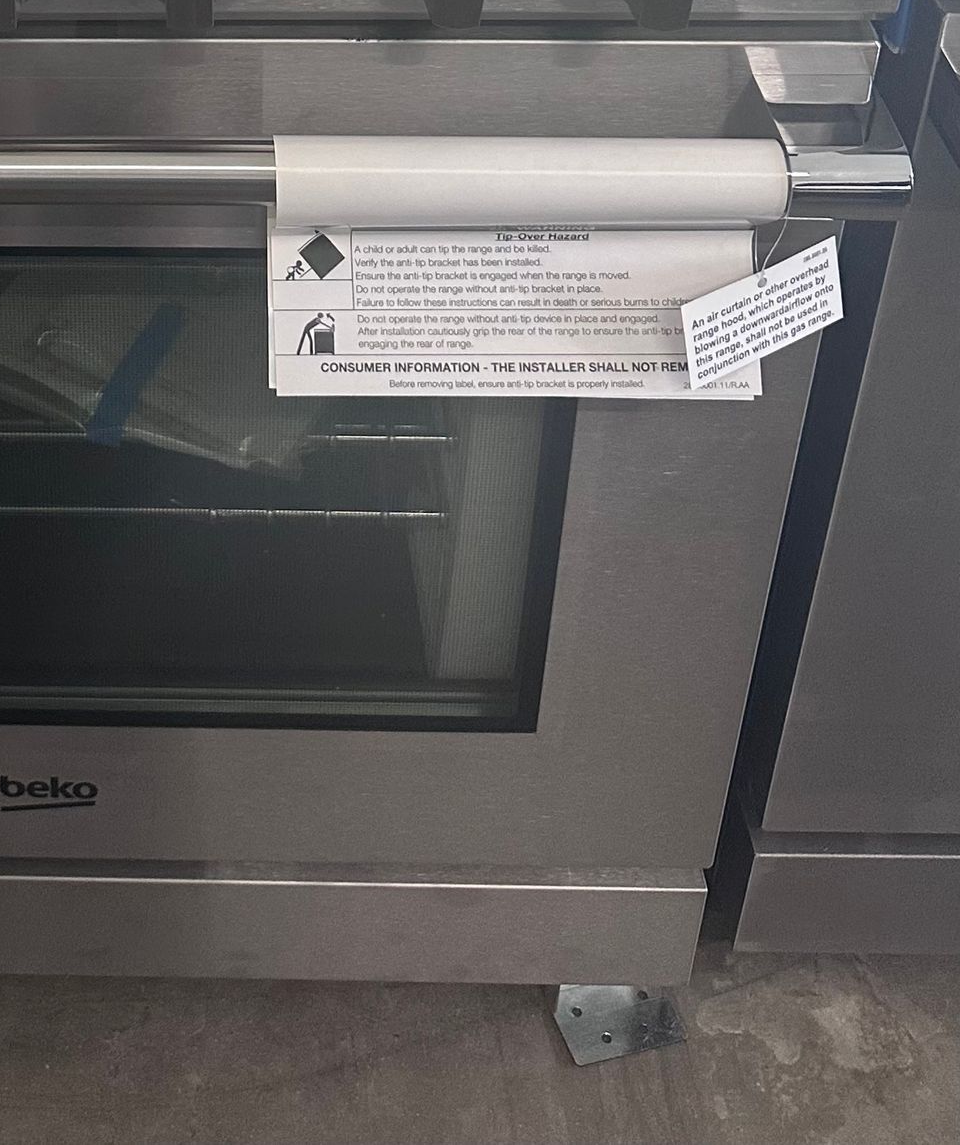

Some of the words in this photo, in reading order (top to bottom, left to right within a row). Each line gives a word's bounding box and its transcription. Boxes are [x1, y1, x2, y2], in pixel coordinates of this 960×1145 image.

[495, 233, 545, 242] Tip-Over
[548, 232, 590, 241] Hazard
[354, 245, 360, 253] A
[362, 245, 383, 253] child
[396, 245, 417, 253] adult
[438, 245, 448, 255] tip
[451, 245, 465, 253] the
[467, 246, 492, 255] range
[494, 245, 511, 253] and
[513, 245, 525, 253] be
[527, 245, 552, 253] killed.
[354, 258, 378, 268] Verify
[380, 258, 394, 266] the
[396, 258, 426, 268] anti-tip
[428, 258, 460, 266] bracket
[462, 258, 478, 266] has
[480, 258, 502, 266] been
[504, 258, 544, 266] installed.
[355, 271, 385, 279] Ensure
[387, 271, 400, 279] the
[403, 271, 433, 281] anti-tip
[434, 271, 467, 279] bracket
[469, 271, 477, 279] is
[479, 271, 517, 281] engaged
[519, 271, 543, 279] when
[545, 271, 560, 279] the
[562, 272, 587, 281] range
[589, 271, 596, 279] is
[598, 271, 632, 279] moved.
[356, 284, 368, 293] Do
[370, 284, 384, 293] not
[386, 284, 420, 294] operate
[422, 284, 436, 293] the
[438, 286, 463, 294] range
[465, 284, 496, 293] without
[499, 284, 529, 294] anti-tip
[531, 284, 564, 293] bracket
[566, 284, 574, 293] in
[576, 284, 603, 294] place.
[692, 318, 704, 330] An
[707, 312, 718, 323] air
[721, 297, 752, 316] curtain
[754, 291, 763, 301] or
[765, 280, 788, 296] other
[790, 260, 829, 284] overhead
[356, 298, 383, 306] Failure
[386, 298, 394, 306] to
[396, 298, 421, 306] follow
[423, 298, 446, 306] these
[448, 298, 497, 306] instructions
[517, 298, 541, 306] result
[542, 298, 551, 306] in
[552, 298, 577, 306] death
[590, 298, 621, 306] serious
[623, 298, 648, 306] burns
[650, 298, 659, 306] to
[693, 326, 719, 342] range
[722, 313, 746, 328] hood,
[748, 299, 774, 316] which
[776, 282, 813, 304] operates
[815, 275, 826, 286] by
[356, 314, 370, 322] Do
[371, 314, 386, 322] not
[388, 314, 421, 324] operate
[424, 314, 438, 322] the
[440, 316, 464, 324] range
[466, 314, 498, 322] without
[501, 314, 531, 324] anti-tip
[533, 314, 562, 322] device
[563, 314, 572, 322] in
[574, 314, 598, 324] place
[600, 314, 617, 322] and
[619, 314, 662, 324] engaged.
[695, 334, 730, 354] blowing
[733, 330, 738, 338] a
[815, 284, 834, 297] onto
[357, 327, 377, 335] After
[380, 327, 425, 335] installation
[427, 327, 470, 337] cautiously
[472, 327, 489, 337] grip
[492, 327, 505, 335] the
[527, 327, 536, 335] of
[538, 327, 552, 335] the
[554, 328, 579, 337] range
[582, 327, 591, 335] to
[625, 327, 638, 335] the
[642, 327, 673, 337] anti-tip
[696, 353, 713, 367] this
[716, 341, 744, 358] range,
[746, 327, 766, 344] shall
[769, 321, 783, 333] not
[785, 314, 795, 326] be
[798, 303, 818, 319] used
[820, 299, 828, 308] in
[358, 340, 398, 350] engaging
[400, 340, 414, 348] the
[435, 340, 444, 348] of
[446, 341, 474, 350] range.
[698, 349, 750, 379] conjunction
[752, 340, 770, 353] with
[772, 331, 789, 343] this
[791, 322, 806, 337] gas
[808, 310, 835, 328] range.
[320, 362, 390, 373] CONSUMER
[394, 362, 479, 373] INFORMATION
[491, 362, 514, 373] THE
[519, 362, 585, 373] INSTALLER
[589, 362, 628, 373] SHALL
[632, 362, 657, 373] NOT
[389, 379, 415, 387] Before
[416, 379, 453, 389] removing
[454, 379, 475, 388] label,
[506, 379, 534, 389] anti-tip
[536, 379, 565, 387] bracket
[567, 379, 574, 387] is
[576, 379, 608, 389] properly
[610, 379, 646, 387] installed.
[0, 775, 98, 799] beko
